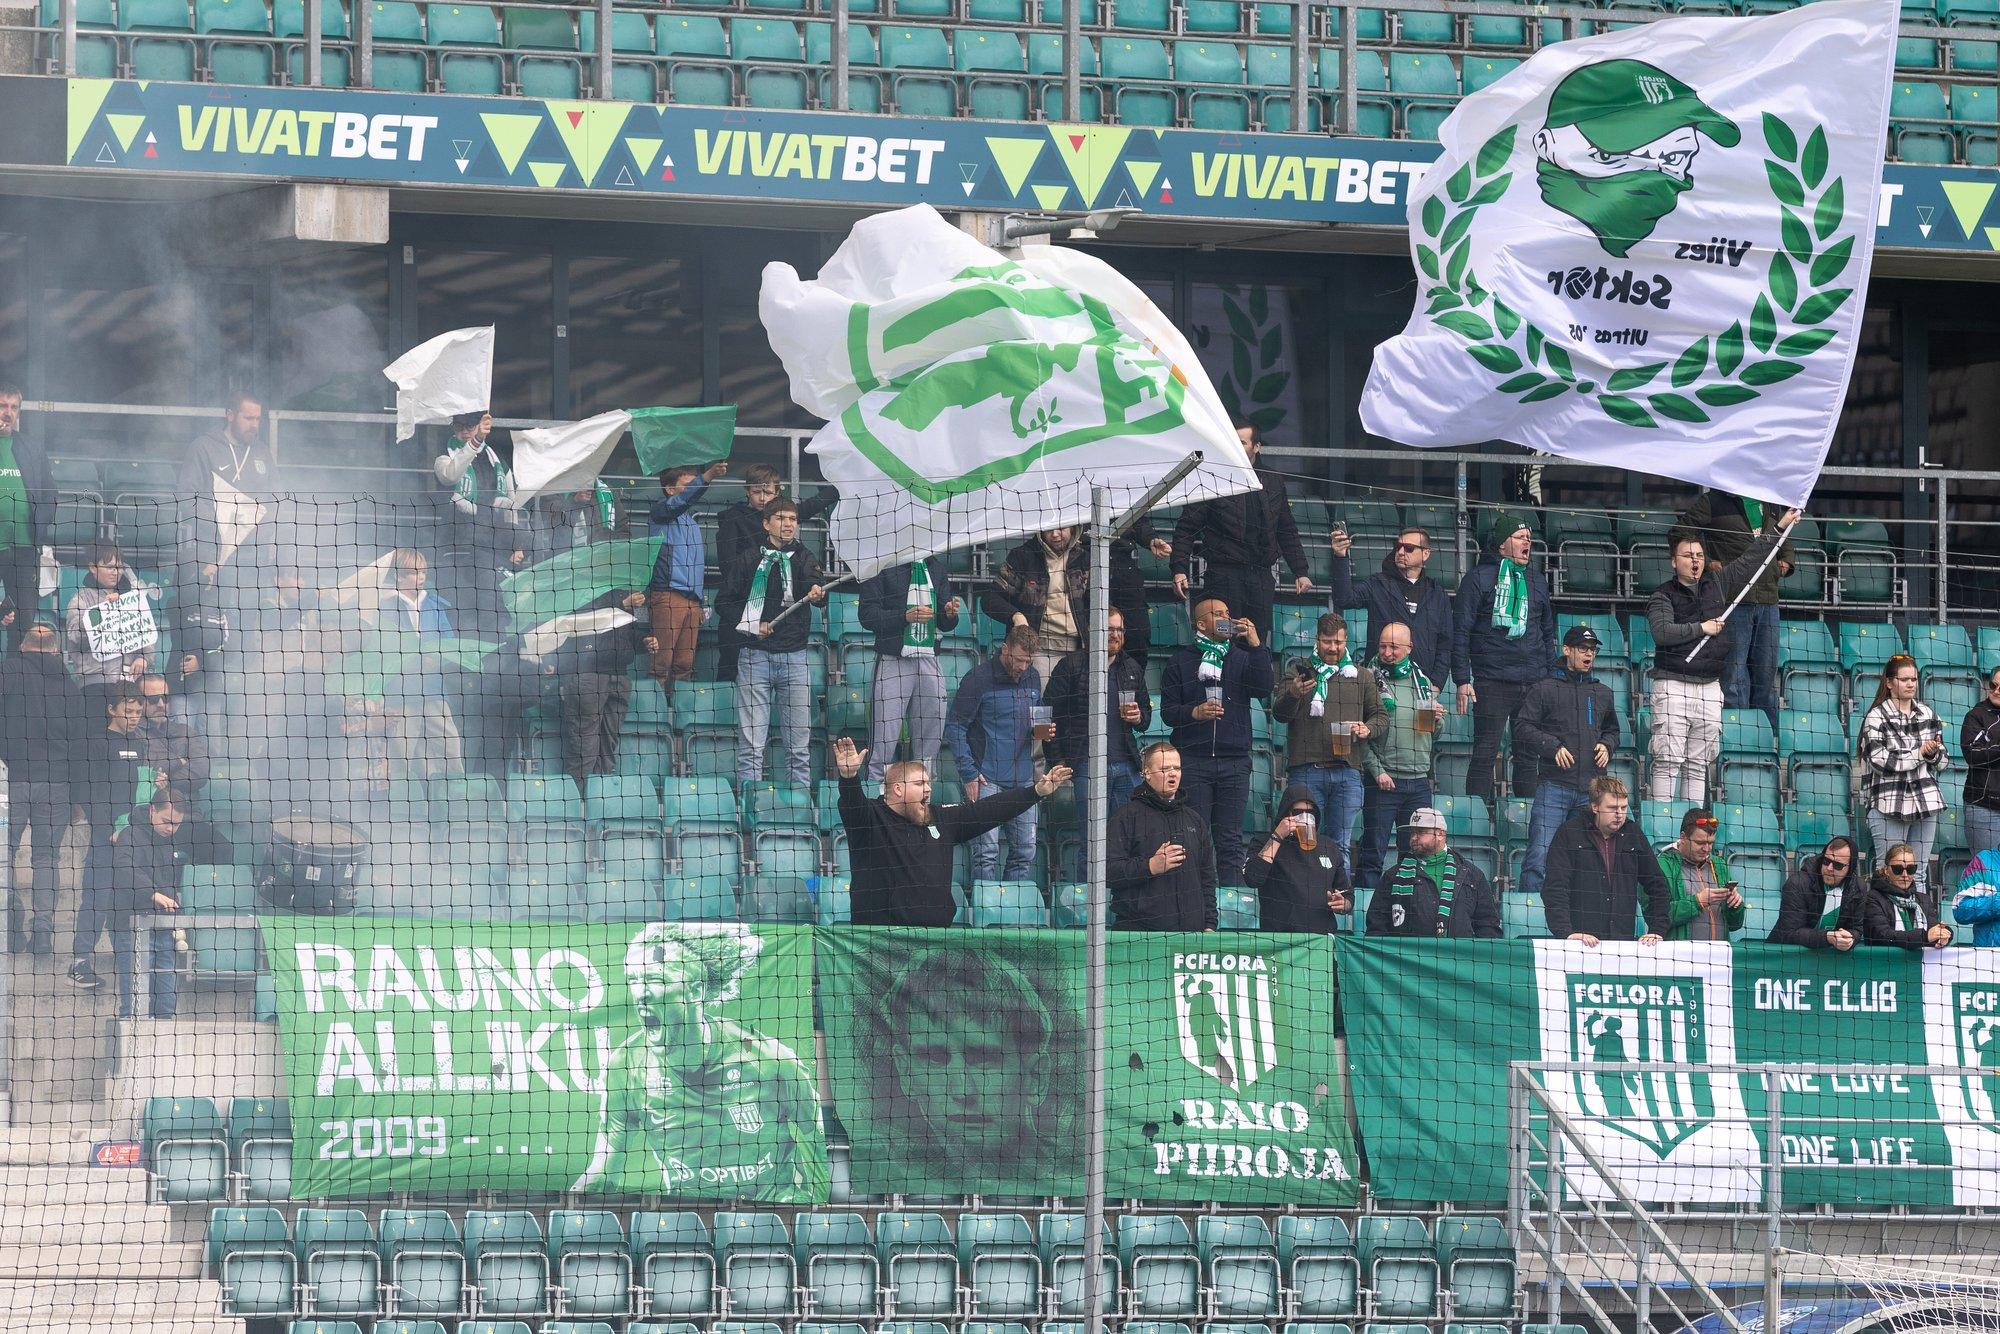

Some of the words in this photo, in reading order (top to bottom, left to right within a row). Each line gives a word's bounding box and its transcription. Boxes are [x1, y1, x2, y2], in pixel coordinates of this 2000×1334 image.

[177, 104, 439, 162] VIVATBET
[694, 128, 946, 184] VIVATBET
[294, 942, 605, 1012] RAUNO
[1754, 978, 1811, 1010] ONE
[1823, 979, 1897, 1012] CLUB
[1689, 985, 1698, 1038] 1990
[316, 1021, 609, 1096] ALLIKU
[1180, 1099, 1309, 1132] RAIO
[320, 1117, 446, 1160] 2009
[1779, 1135, 1839, 1164] ONE
[1850, 1136, 1918, 1165] LIFE
[700, 1152, 774, 1182] OPTIBET
[1153, 1142, 1351, 1180] PIIROJA
